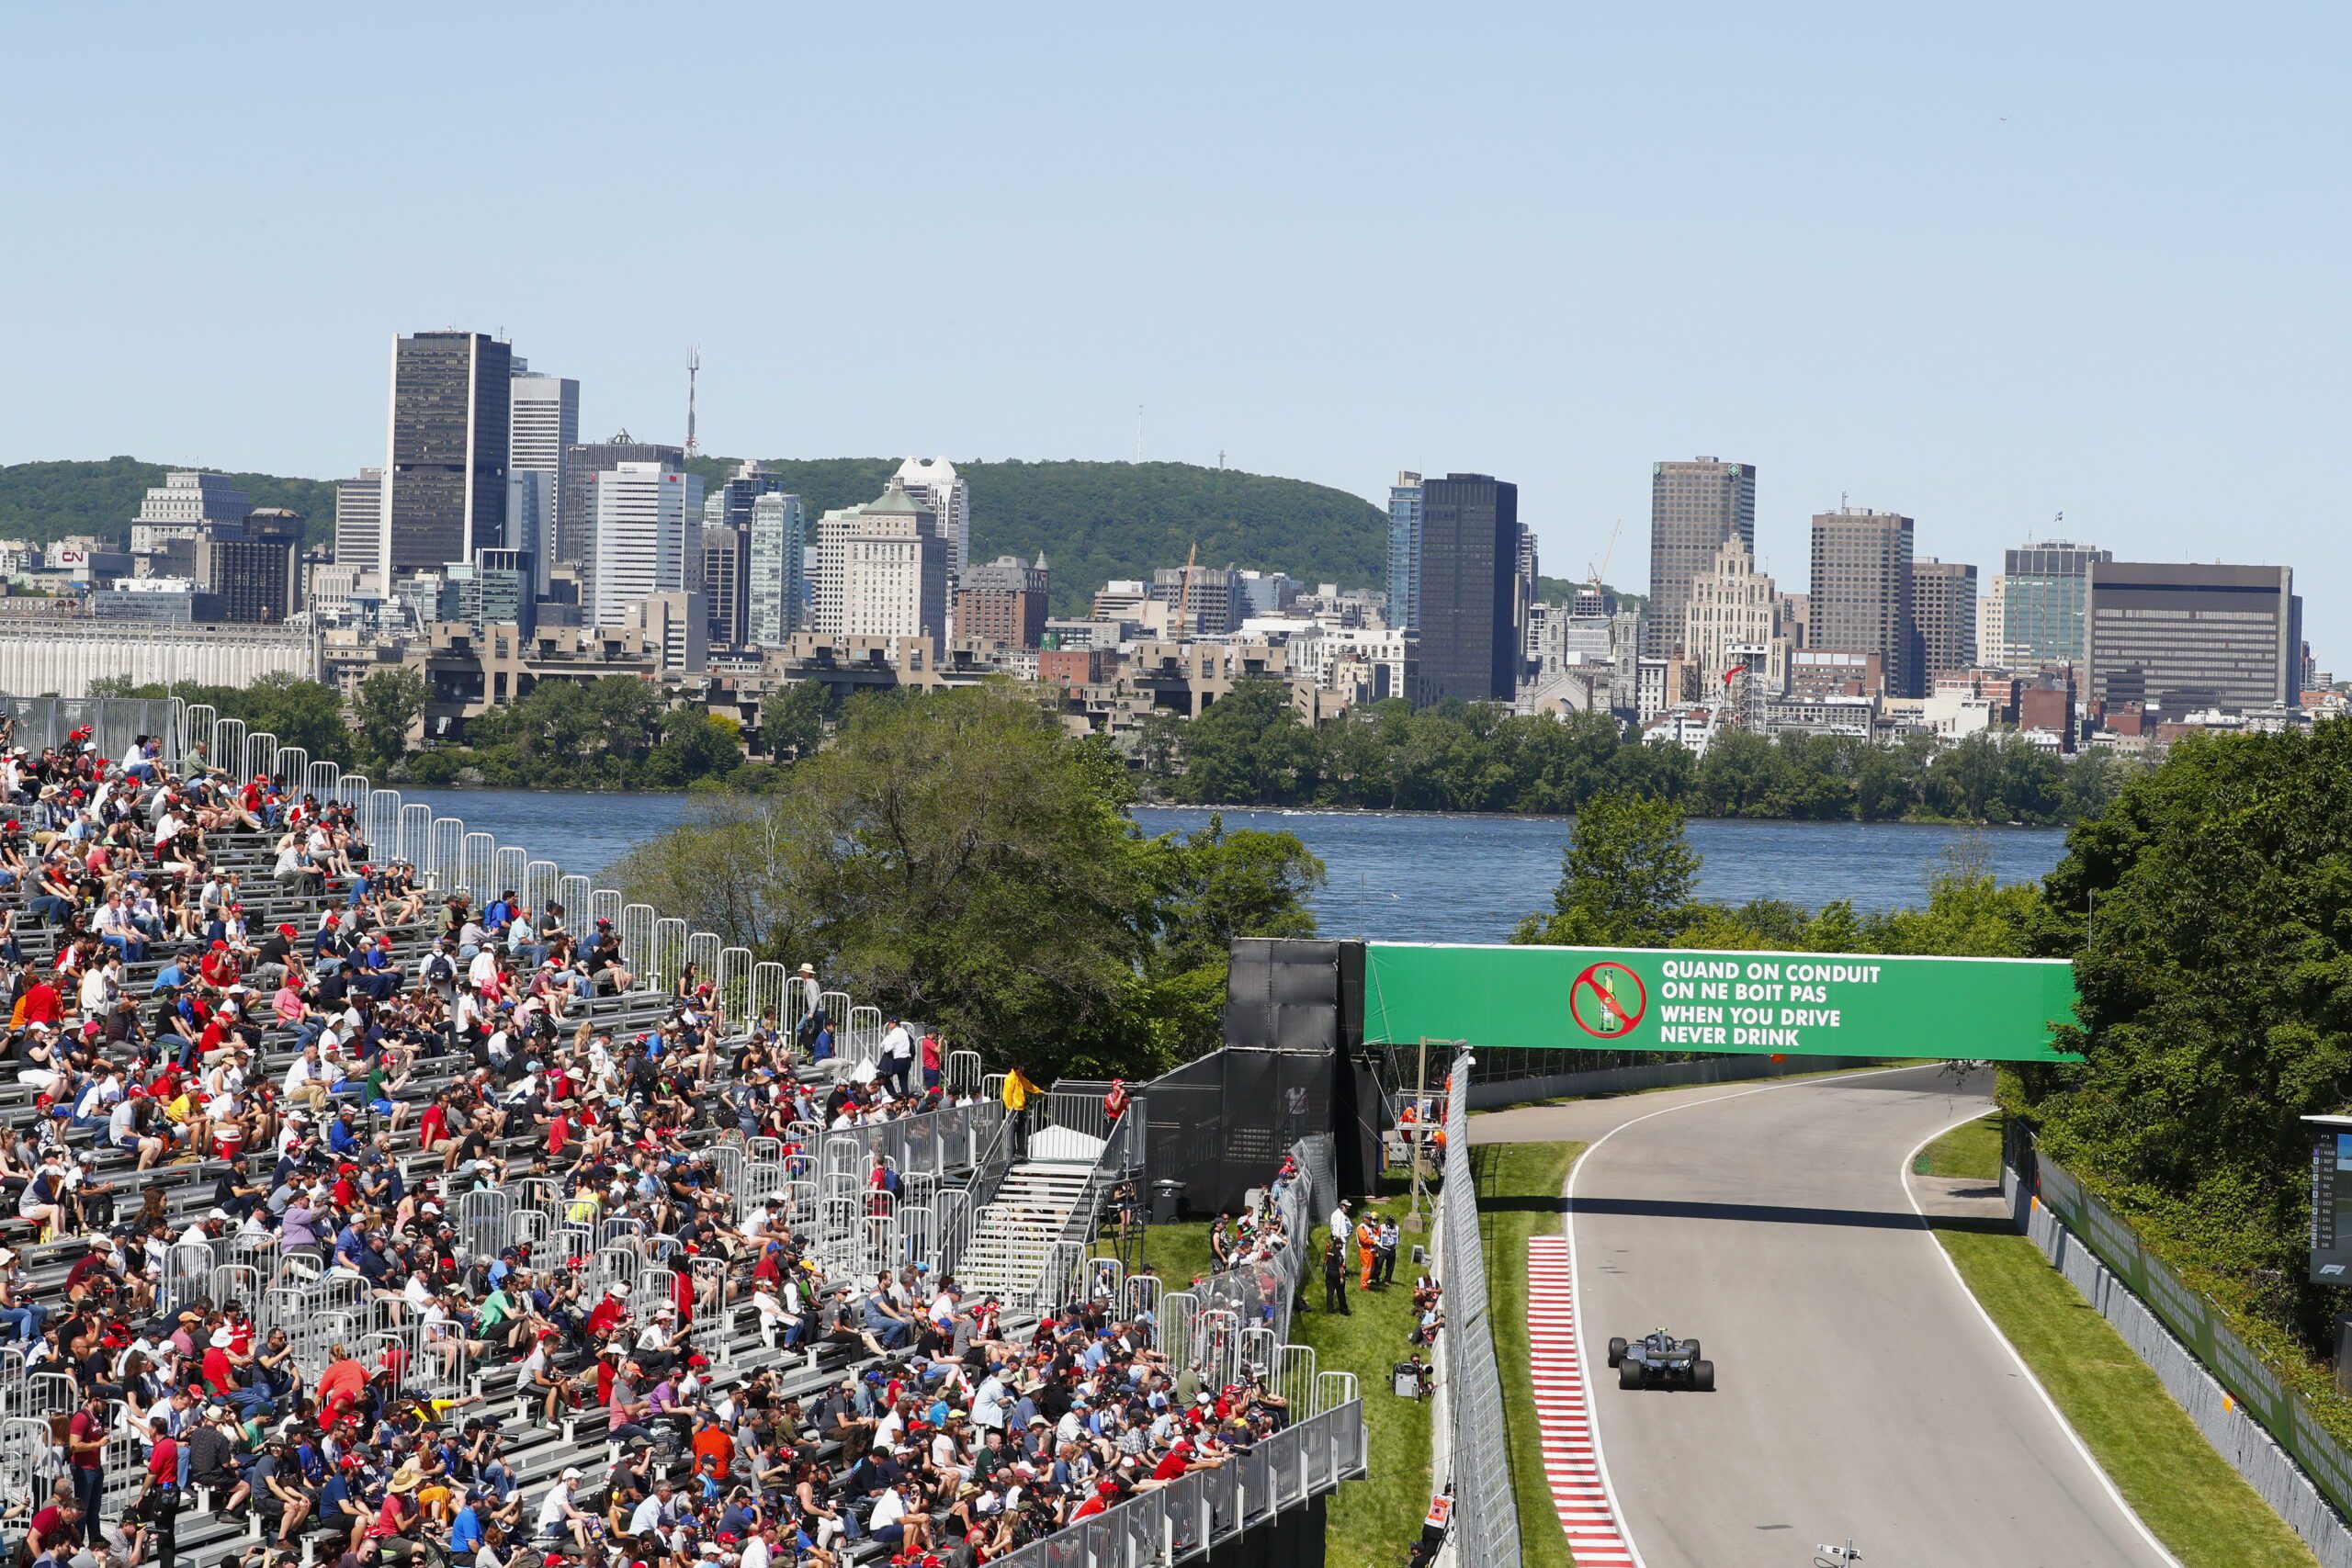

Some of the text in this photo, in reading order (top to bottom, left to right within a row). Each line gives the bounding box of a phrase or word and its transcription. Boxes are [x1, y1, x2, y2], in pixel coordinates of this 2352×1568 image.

[62, 551, 84, 562] CN
[1662, 960, 1882, 984] QUAND ON CONDUIT
[1661, 981, 1827, 1004] ON NE BOIT PAS
[1660, 1005, 1841, 1028] WHEN YOU DRIVE
[1660, 1025, 1800, 1046] NEVER DRINK
